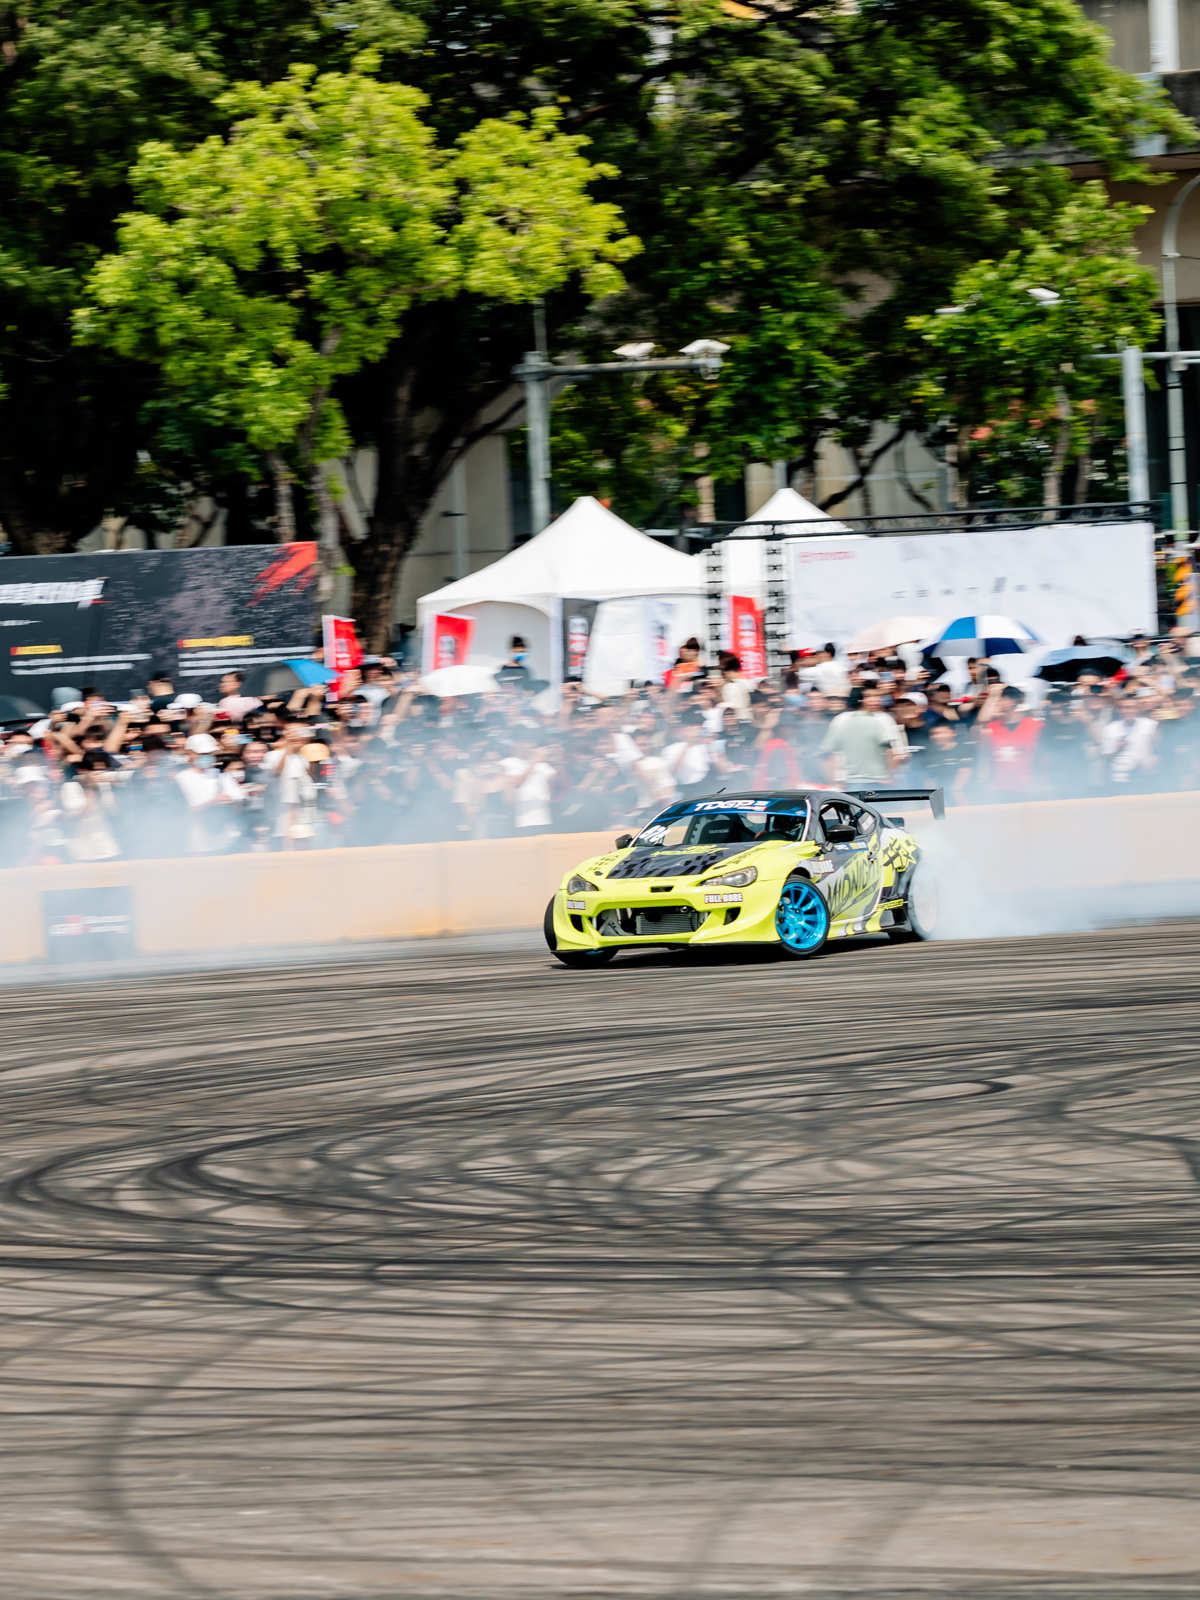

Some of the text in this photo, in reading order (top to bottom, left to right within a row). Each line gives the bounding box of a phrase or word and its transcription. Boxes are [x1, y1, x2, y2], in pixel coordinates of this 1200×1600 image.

[694, 800, 755, 811] TDGP
[705, 893, 743, 904] FULL BORE
